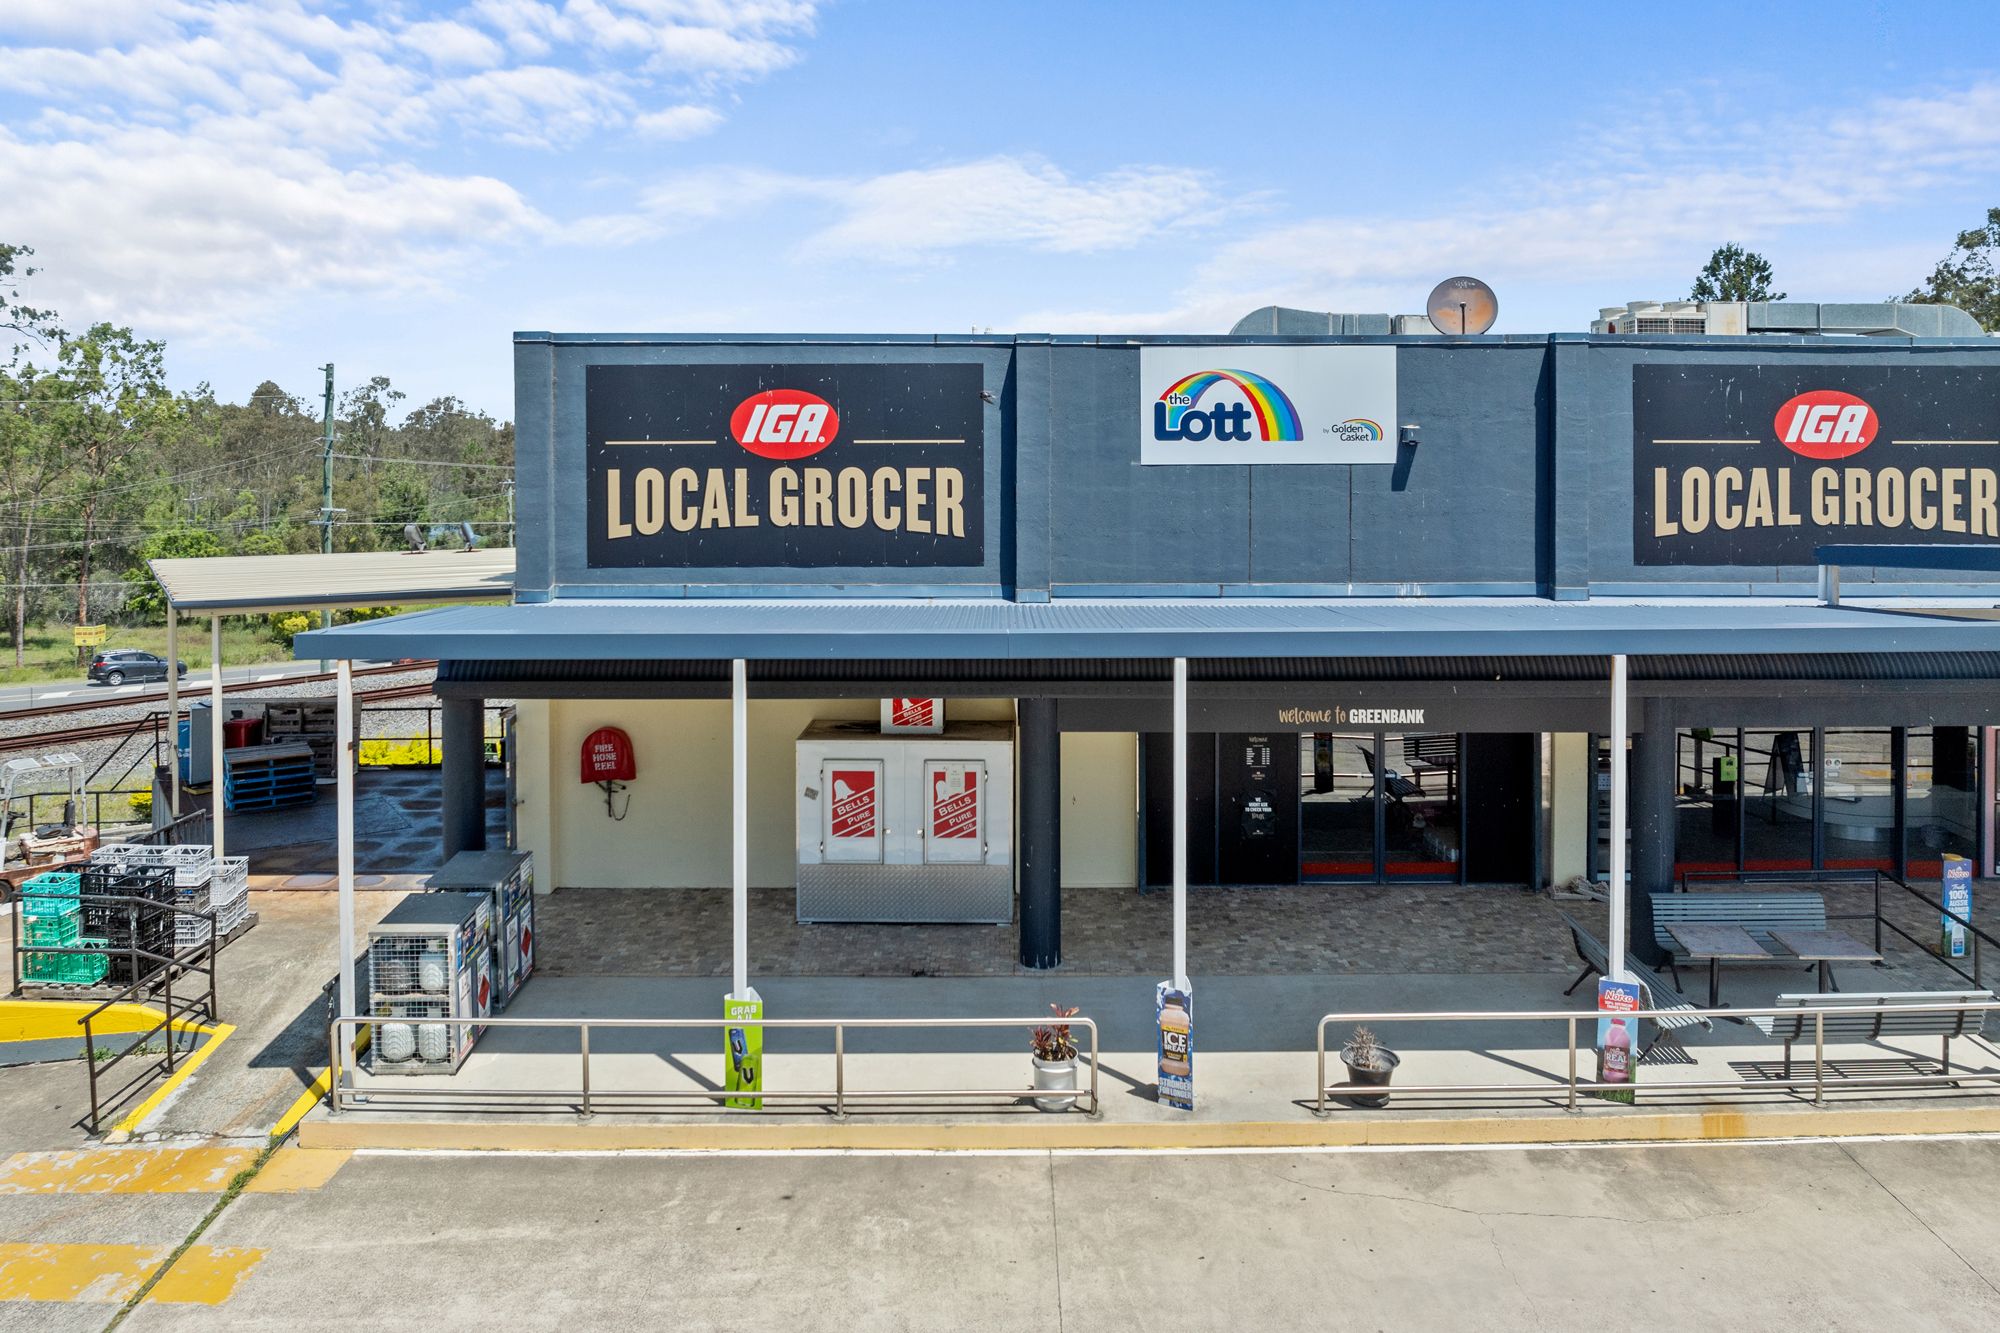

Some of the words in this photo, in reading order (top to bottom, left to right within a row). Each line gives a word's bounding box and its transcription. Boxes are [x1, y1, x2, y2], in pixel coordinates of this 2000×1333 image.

[1168, 393, 1190, 405] the
[742, 403, 828, 443] IGA
[1154, 402, 1251, 442] Lott
[1785, 404, 1869, 443] IGA
[1331, 424, 1364, 433] Golden
[1340, 432, 1369, 441] Casket
[607, 466, 760, 540] LOCAL
[769, 466, 965, 538] GROCER
[1655, 466, 1802, 538] LOCAL
[1811, 466, 1999, 538] GROCER
[903, 706, 922, 717] BELLS
[1278, 706, 1331, 725] welcome
[1335, 705, 1346, 724] to
[1349, 708, 1425, 724] GREENBANK
[594, 743, 614, 753] FIRE
[592, 752, 616, 762] HOSE
[594, 761, 616, 771] REEL
[836, 795, 870, 816] BELLS
[938, 796, 972, 817] BELLS
[847, 810, 871, 825] PURE
[949, 811, 973, 826] PURE
[861, 822, 872, 831] ICE
[963, 823, 973, 831] ICE
[1947, 867, 1969, 878] Norco
[1948, 890, 1968, 900] 100%
[1604, 989, 1633, 1003] Norco
[731, 1005, 757, 1016] GRAB
[1163, 1031, 1187, 1047] ICE
[1164, 1043, 1186, 1053] BREAK
[1606, 1053, 1627, 1064] REAL
